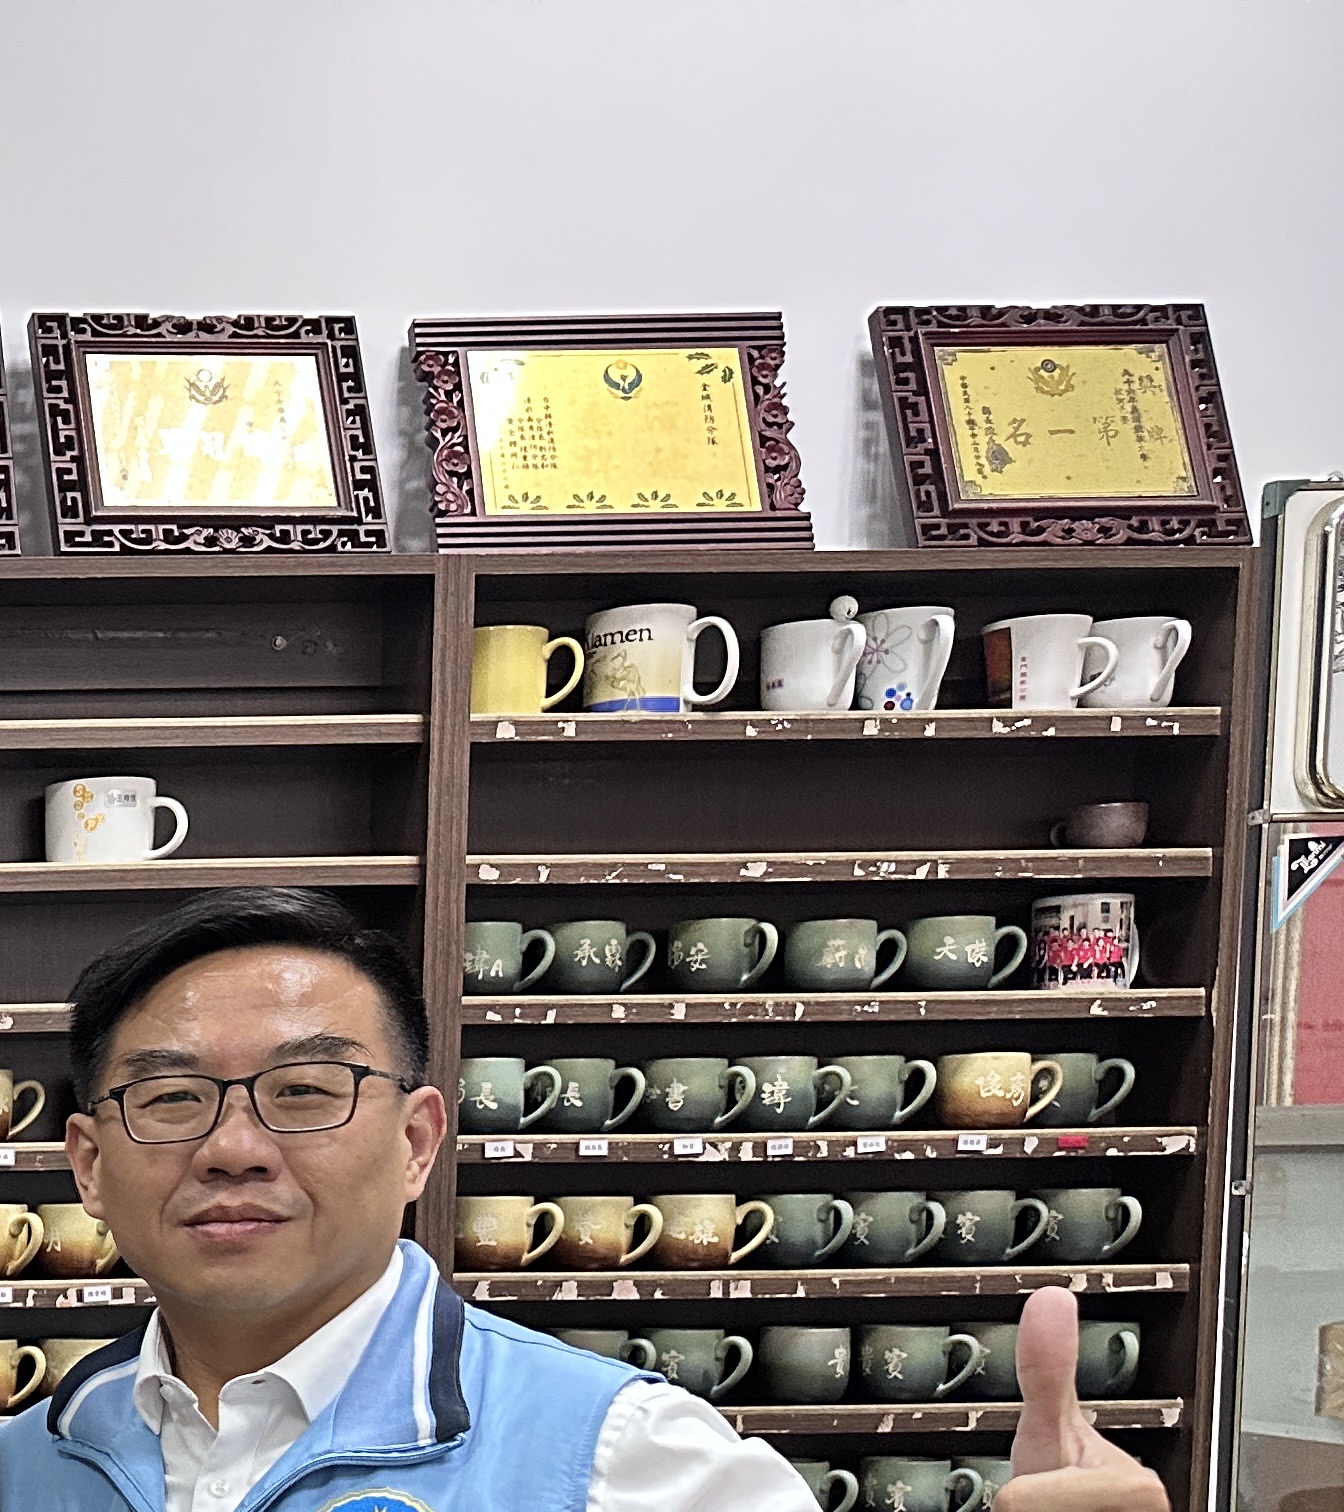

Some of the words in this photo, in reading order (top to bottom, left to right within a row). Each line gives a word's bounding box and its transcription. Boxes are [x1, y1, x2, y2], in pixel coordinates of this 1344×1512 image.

[701, 383, 718, 446] 金城消防分隊
[1004, 416, 1119, 447] 第一名
